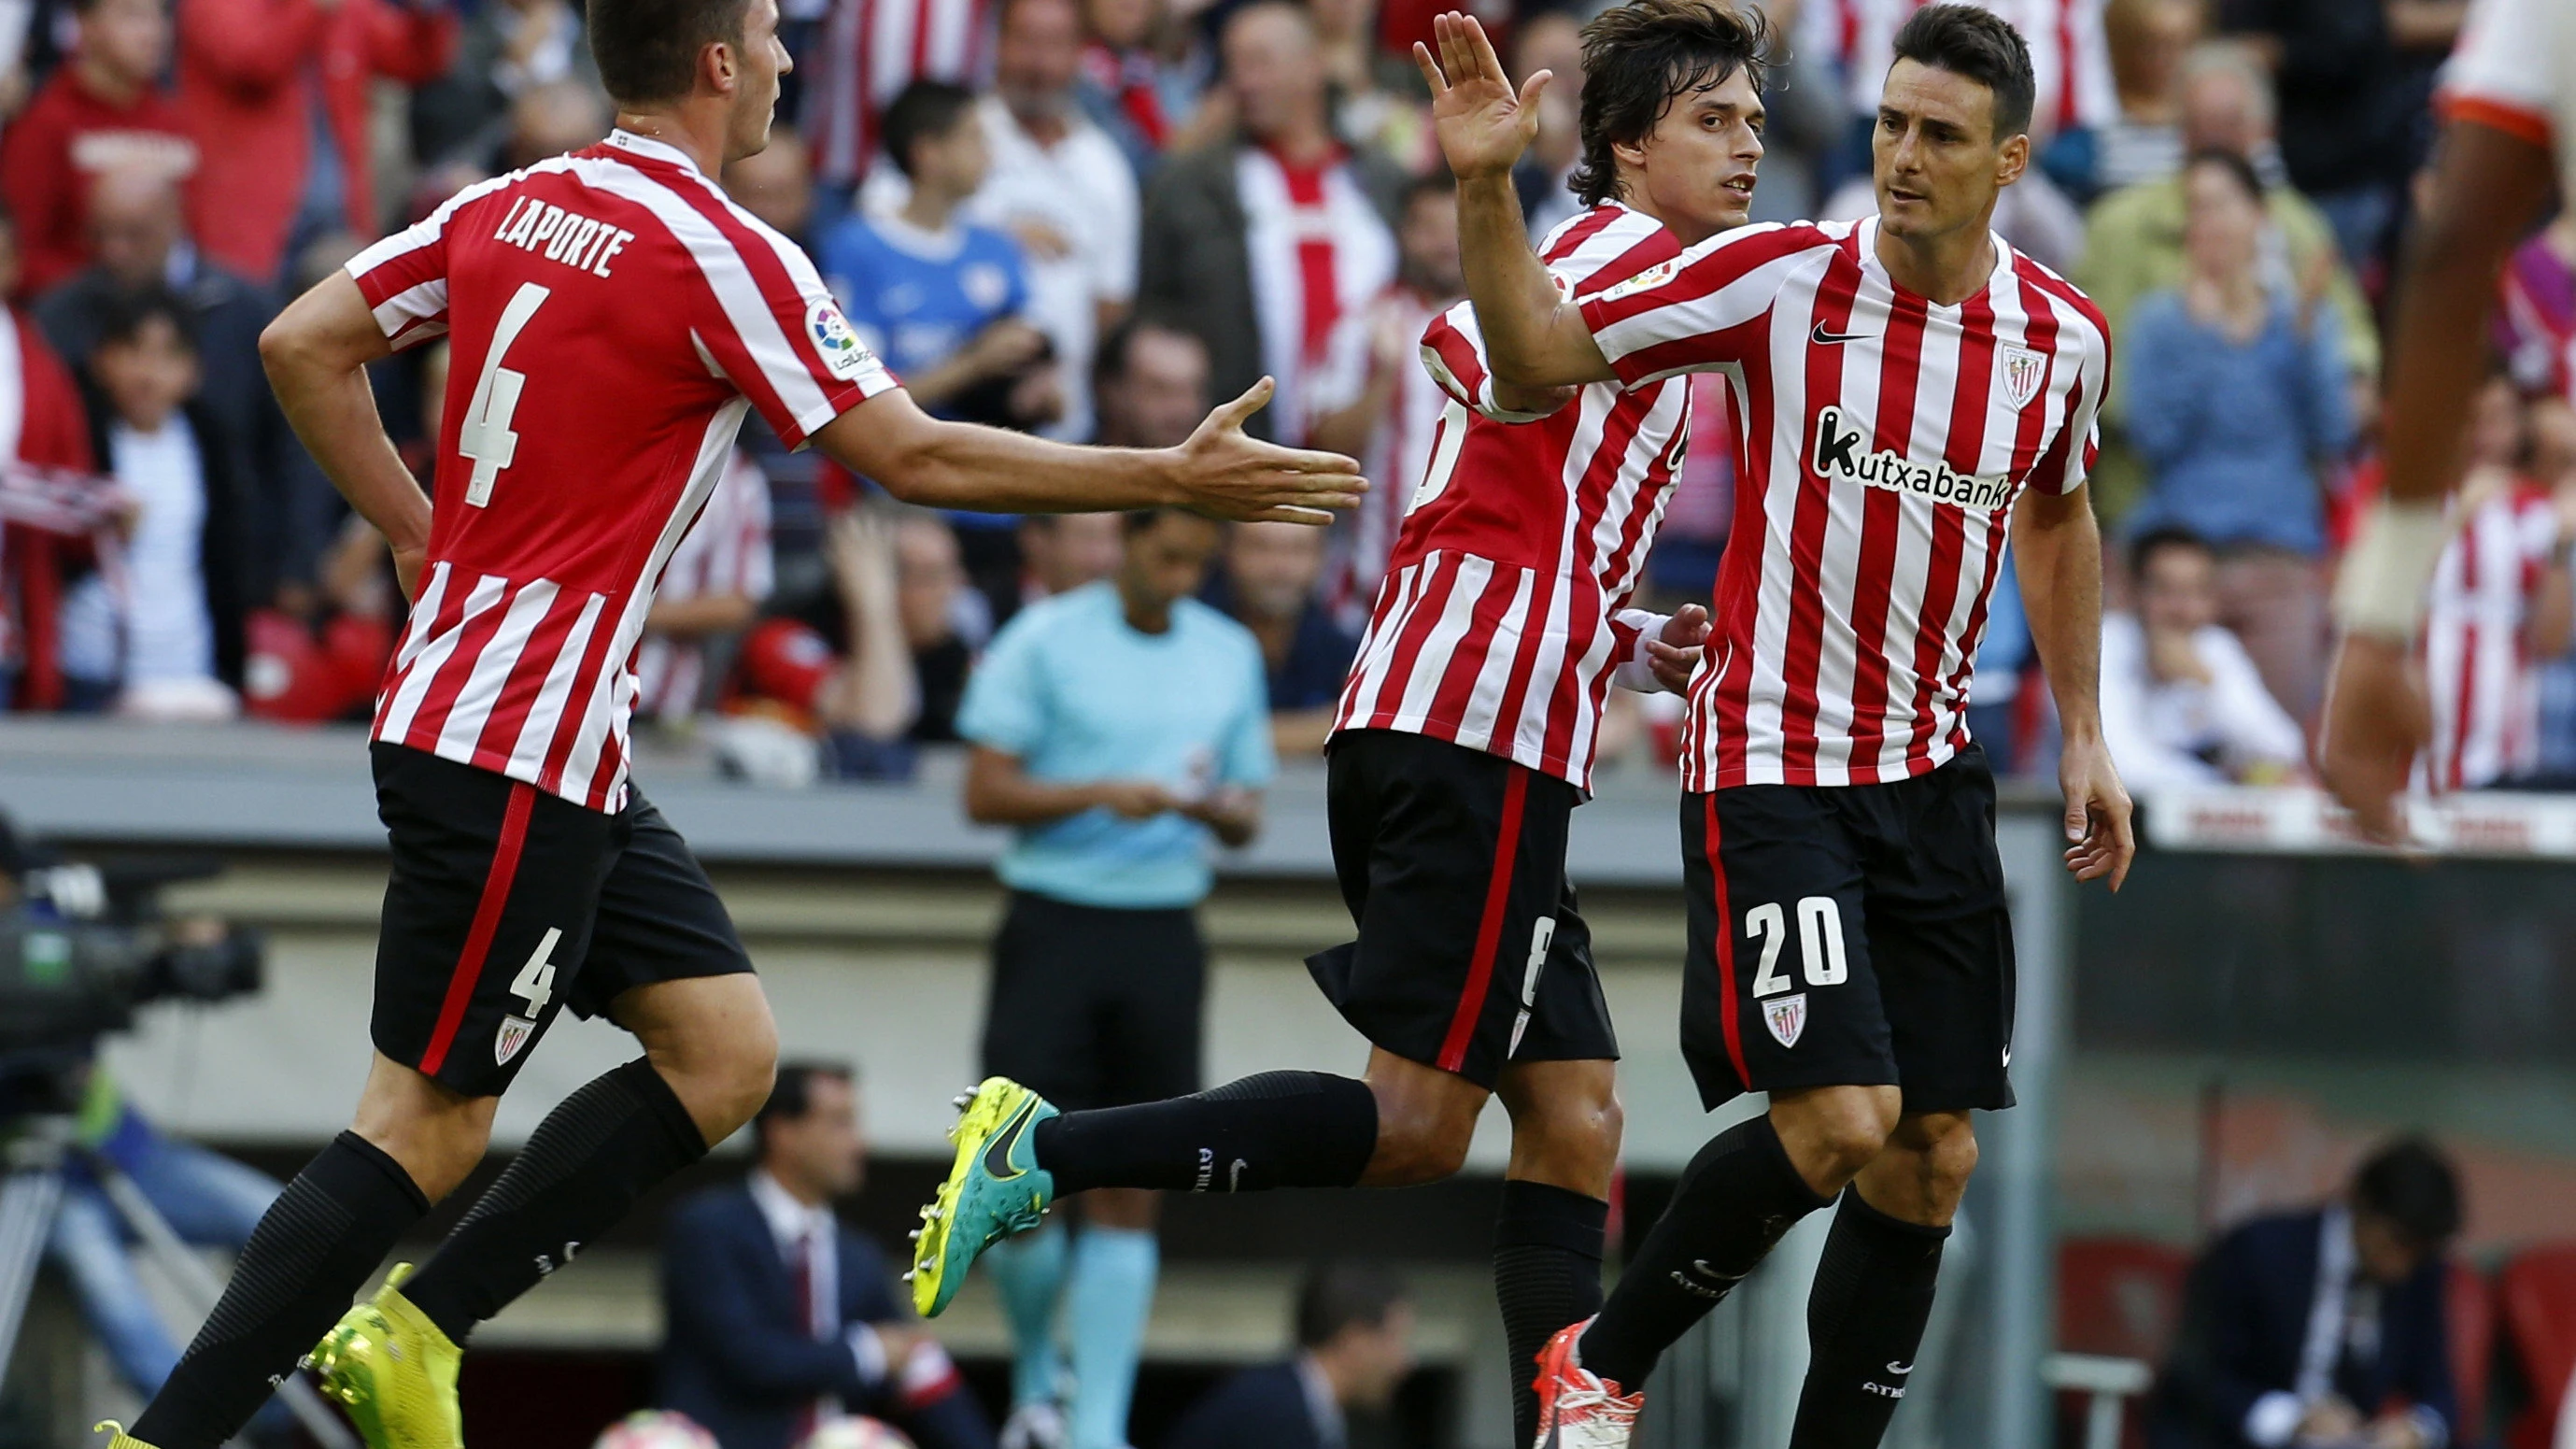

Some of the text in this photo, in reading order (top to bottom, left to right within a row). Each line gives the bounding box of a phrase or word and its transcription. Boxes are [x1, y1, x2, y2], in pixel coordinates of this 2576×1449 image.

[493, 194, 636, 278] LAPORTE
[458, 281, 552, 508] 4
[1817, 410, 2011, 507] Kutxabank
[509, 926, 562, 1019] 4
[1745, 896, 1848, 999] 20
